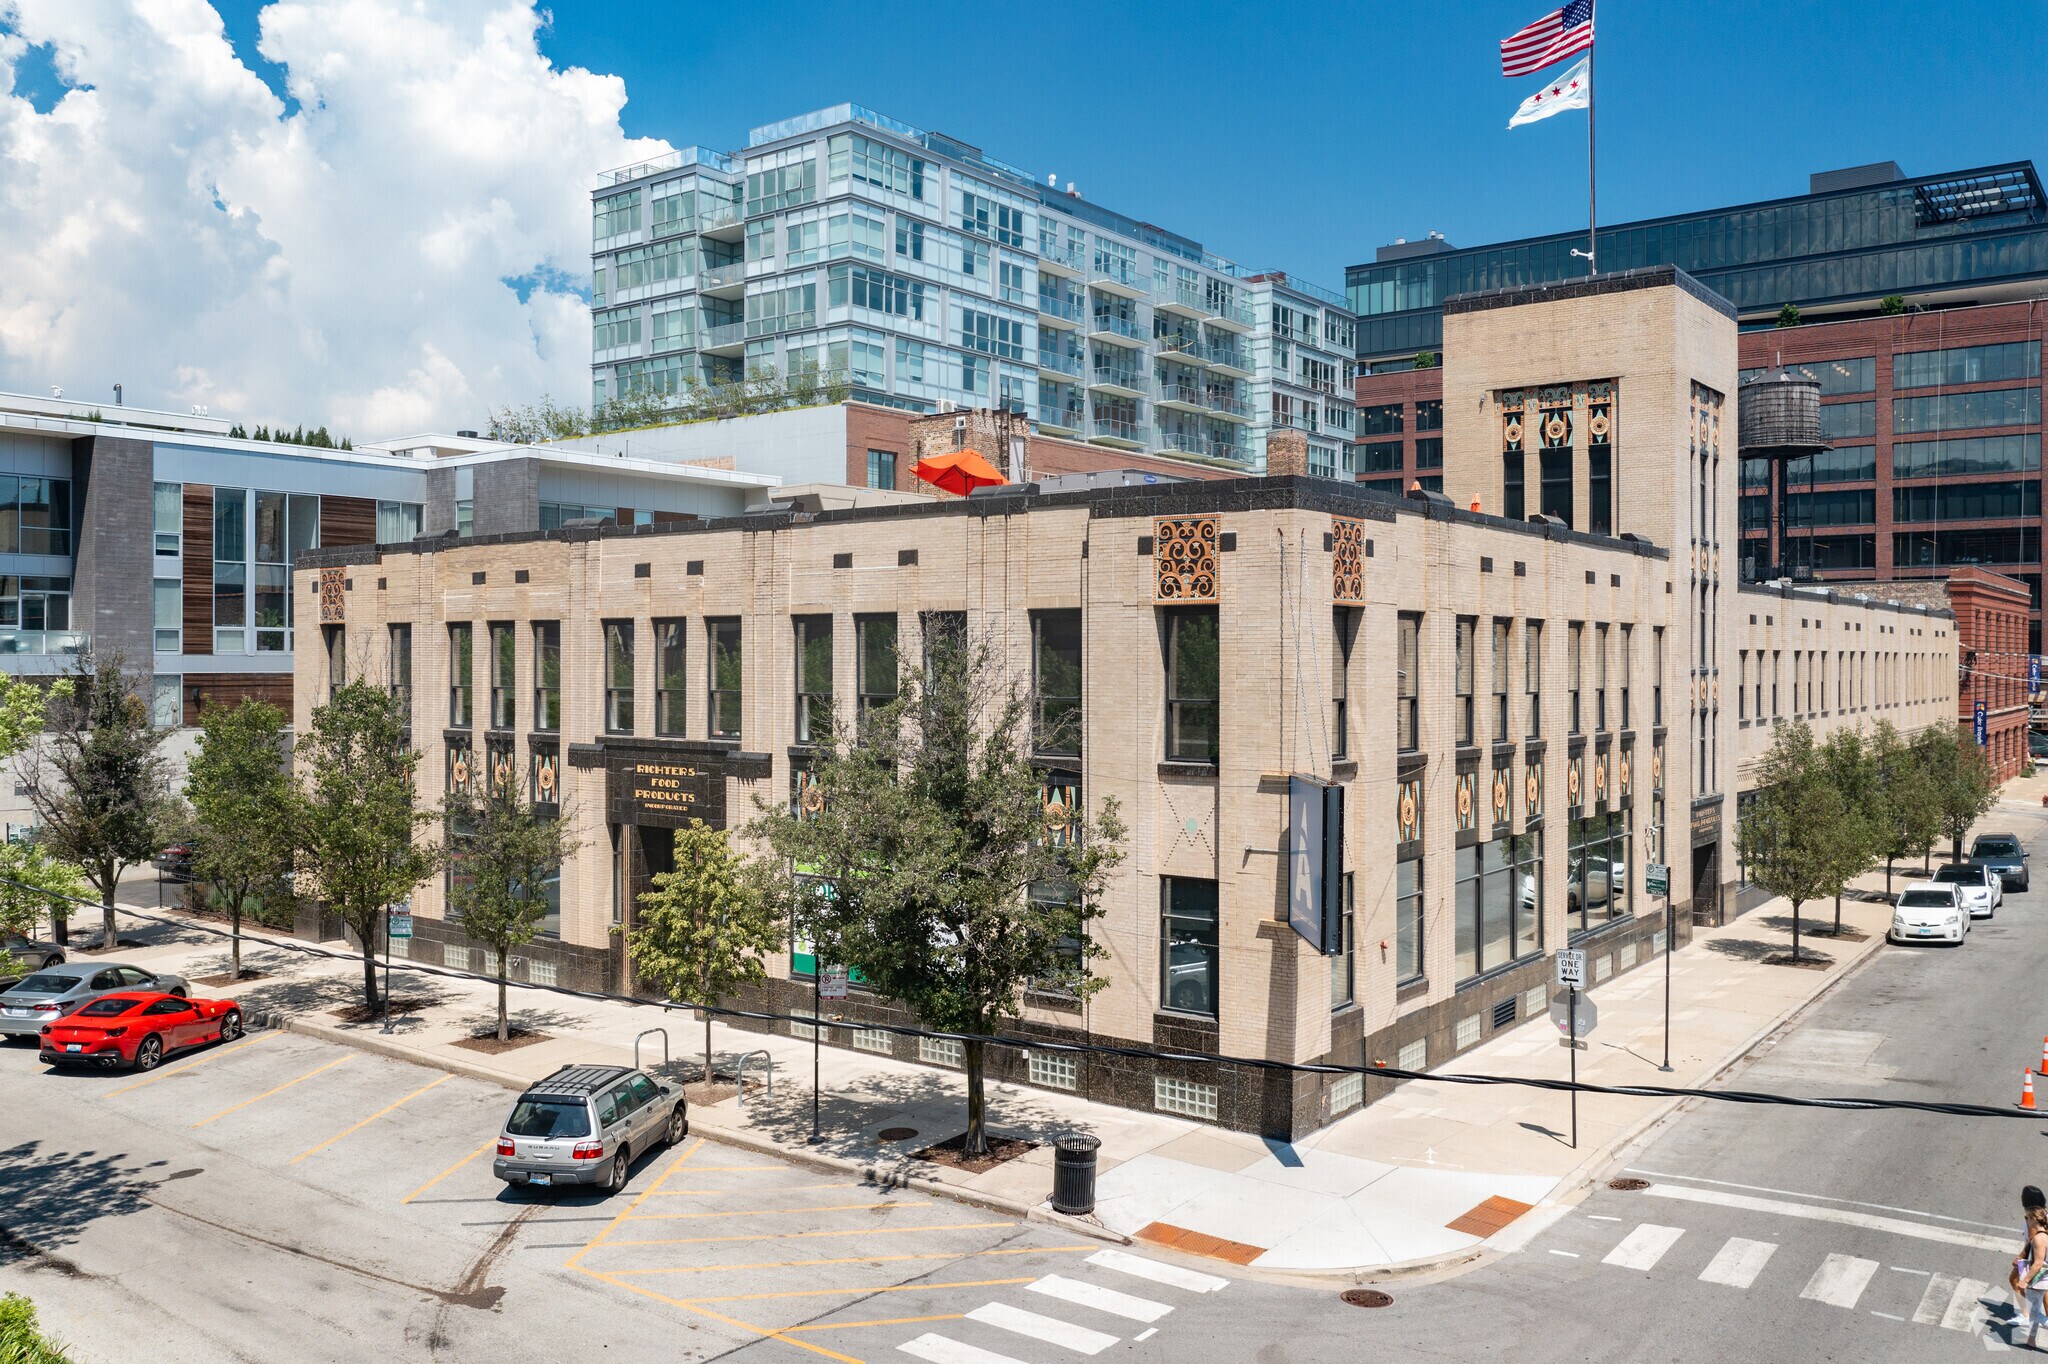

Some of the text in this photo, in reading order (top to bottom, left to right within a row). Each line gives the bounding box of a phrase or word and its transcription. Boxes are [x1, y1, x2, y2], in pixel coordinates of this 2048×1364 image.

[651, 777, 680, 789] FOOD
[635, 789, 695, 803] PRODUCTS
[1561, 959, 1579, 968] ONE
[1561, 967, 1579, 976] WAY
